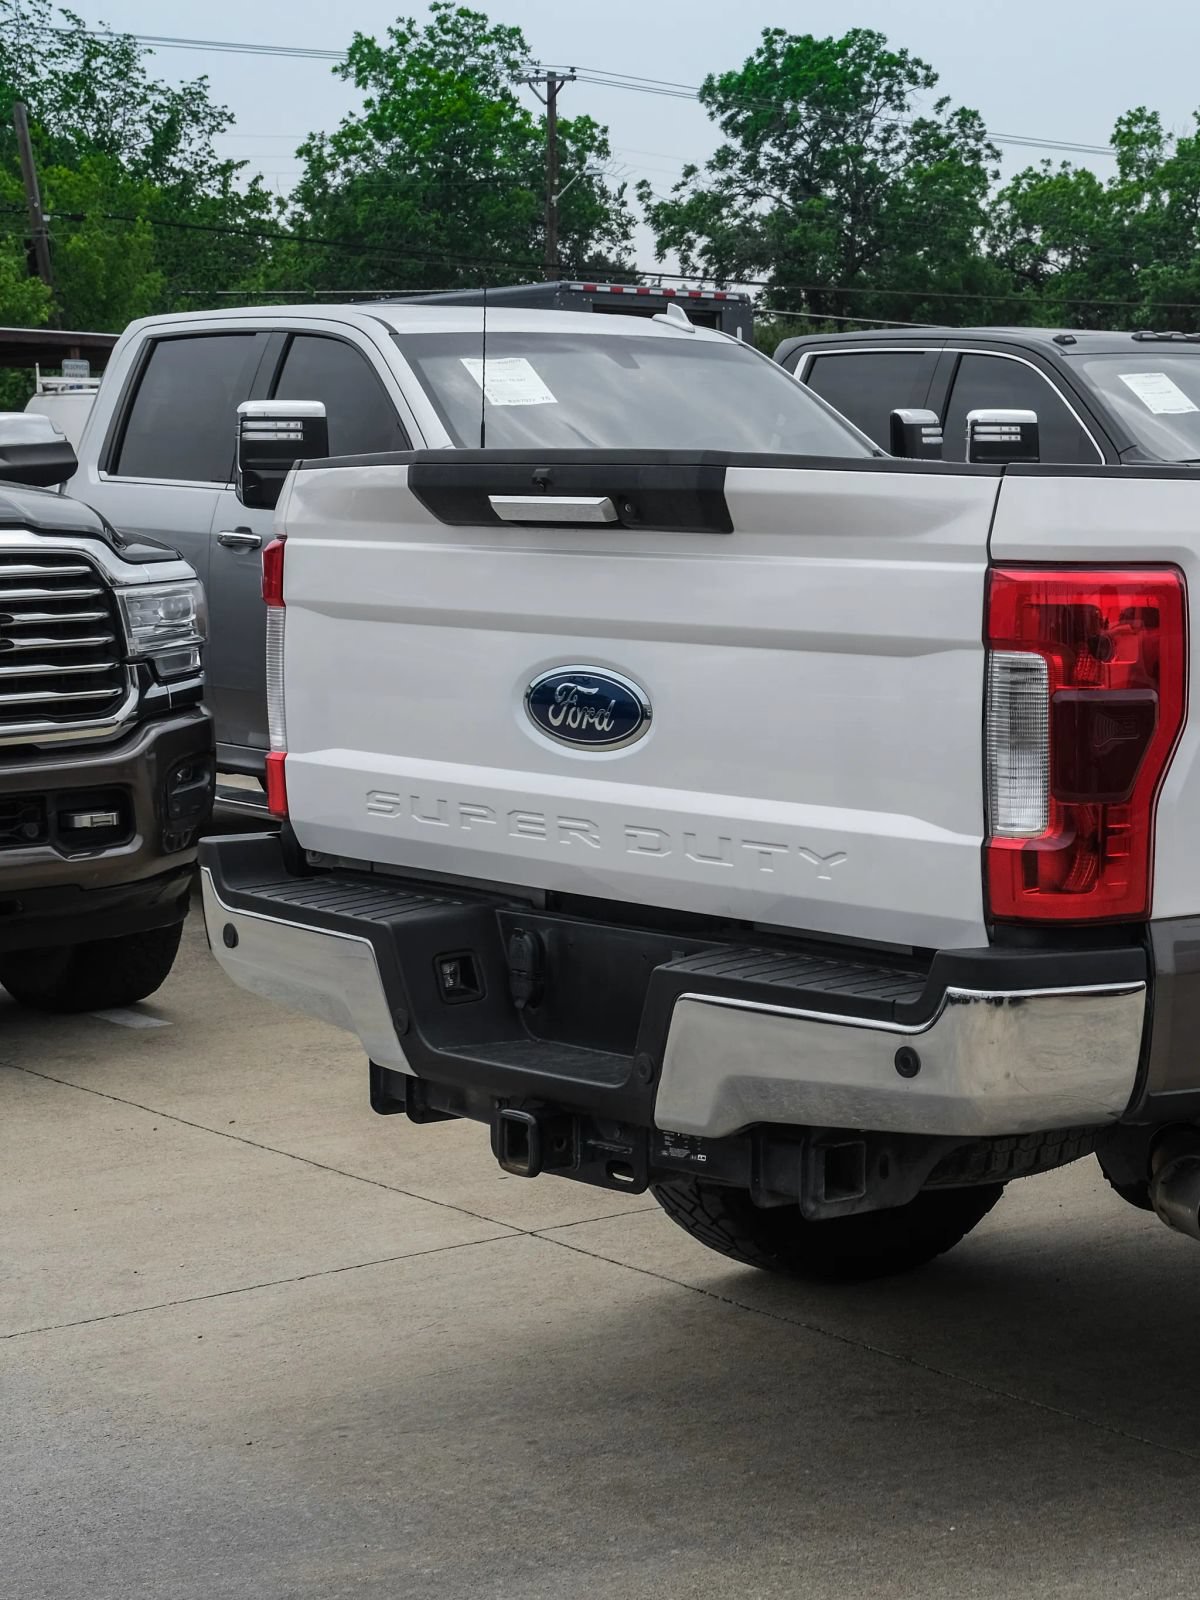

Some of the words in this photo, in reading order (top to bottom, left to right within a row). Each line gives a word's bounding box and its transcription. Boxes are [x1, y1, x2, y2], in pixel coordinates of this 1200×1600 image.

[548, 682, 616, 732] Ford
[365, 789, 601, 849] SUPER
[624, 824, 848, 881] DUTY
